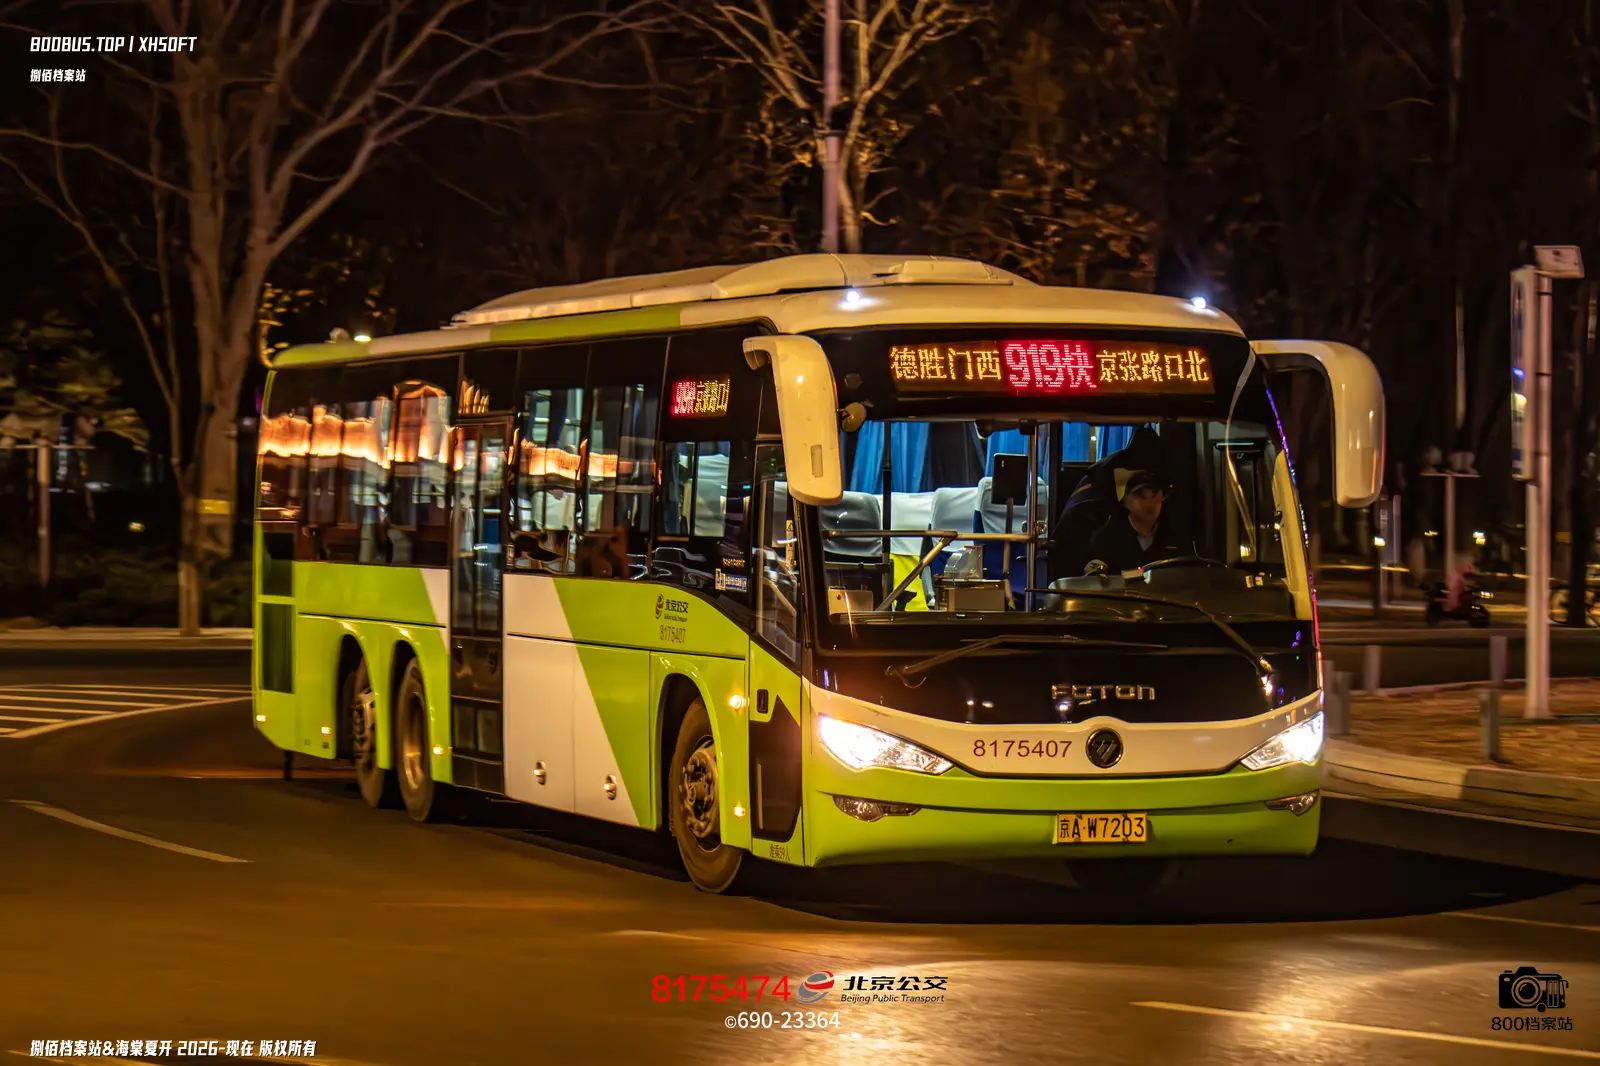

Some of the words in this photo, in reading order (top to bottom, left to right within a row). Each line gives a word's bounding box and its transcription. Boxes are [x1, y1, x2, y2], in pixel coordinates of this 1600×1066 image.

[890, 347, 1002, 380] 德胜门西
[1004, 342, 1097, 388] 919快
[1096, 349, 1209, 382] 京张路口北
[973, 739, 1073, 758] 8175407
